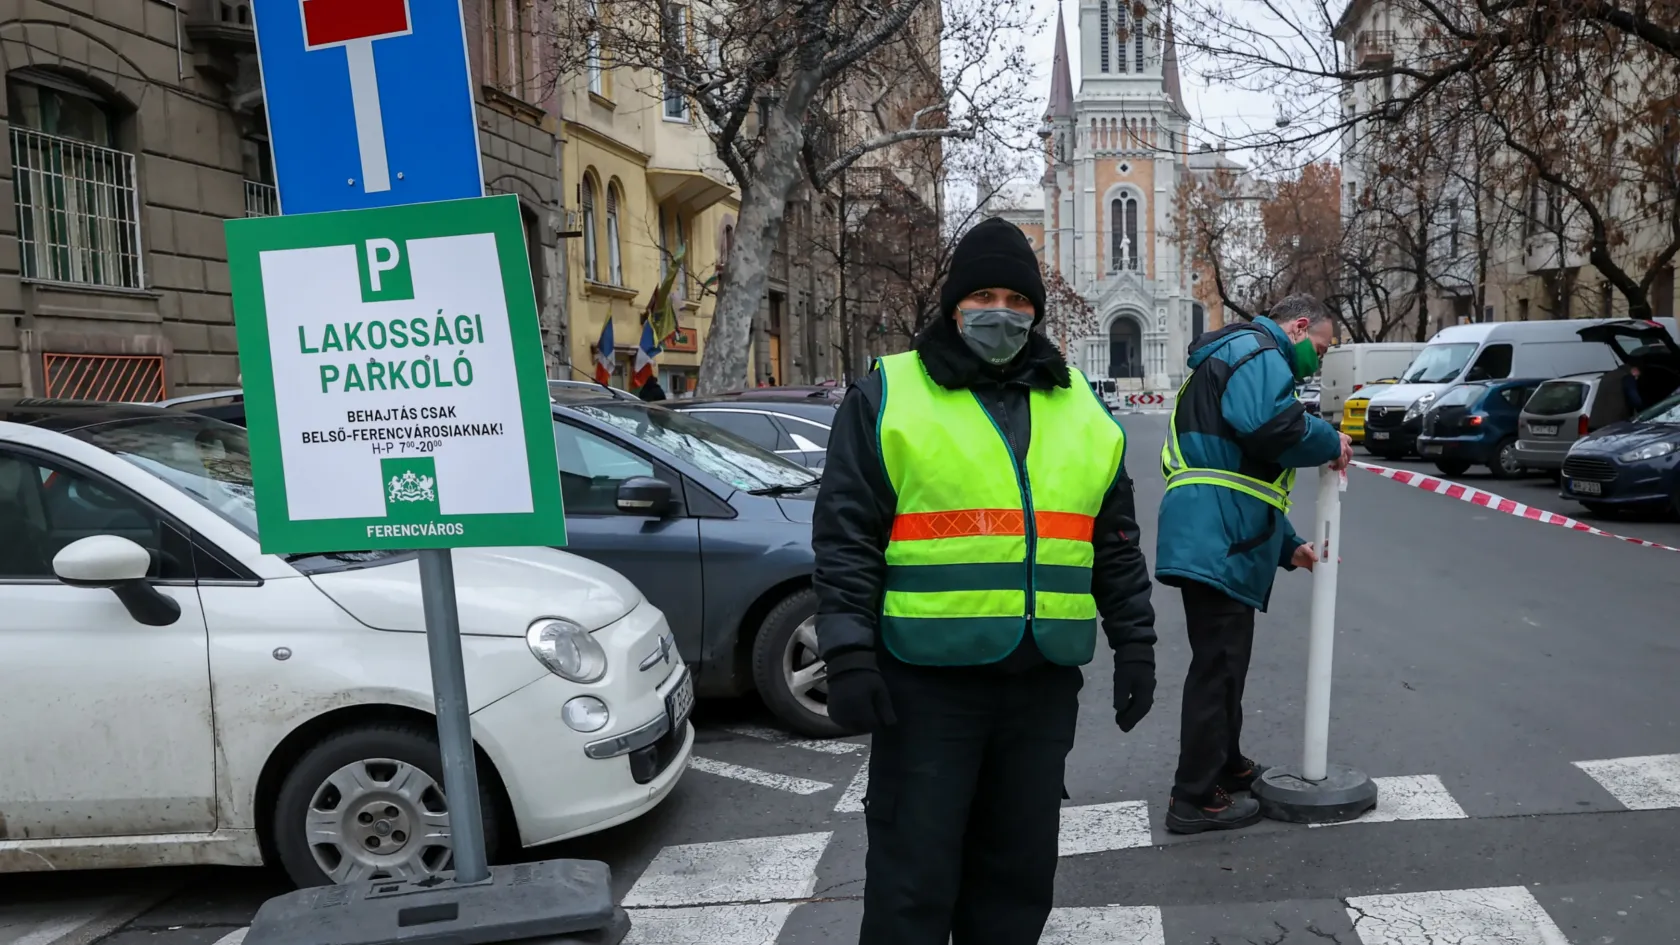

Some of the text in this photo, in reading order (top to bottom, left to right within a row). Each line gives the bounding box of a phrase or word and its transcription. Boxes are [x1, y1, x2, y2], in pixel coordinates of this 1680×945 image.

[365, 237, 400, 292] P
[298, 309, 485, 355] LAKOSSÁGI
[319, 350, 474, 394] PARKOLÓ
[347, 405, 457, 423] BEHAJTÁS CSAK
[301, 423, 504, 444] BELSŐ-FERENCVÁROSIAKNAK!
[371, 441, 394, 455] H-P
[366, 520, 464, 538] FERENCVÁROS
